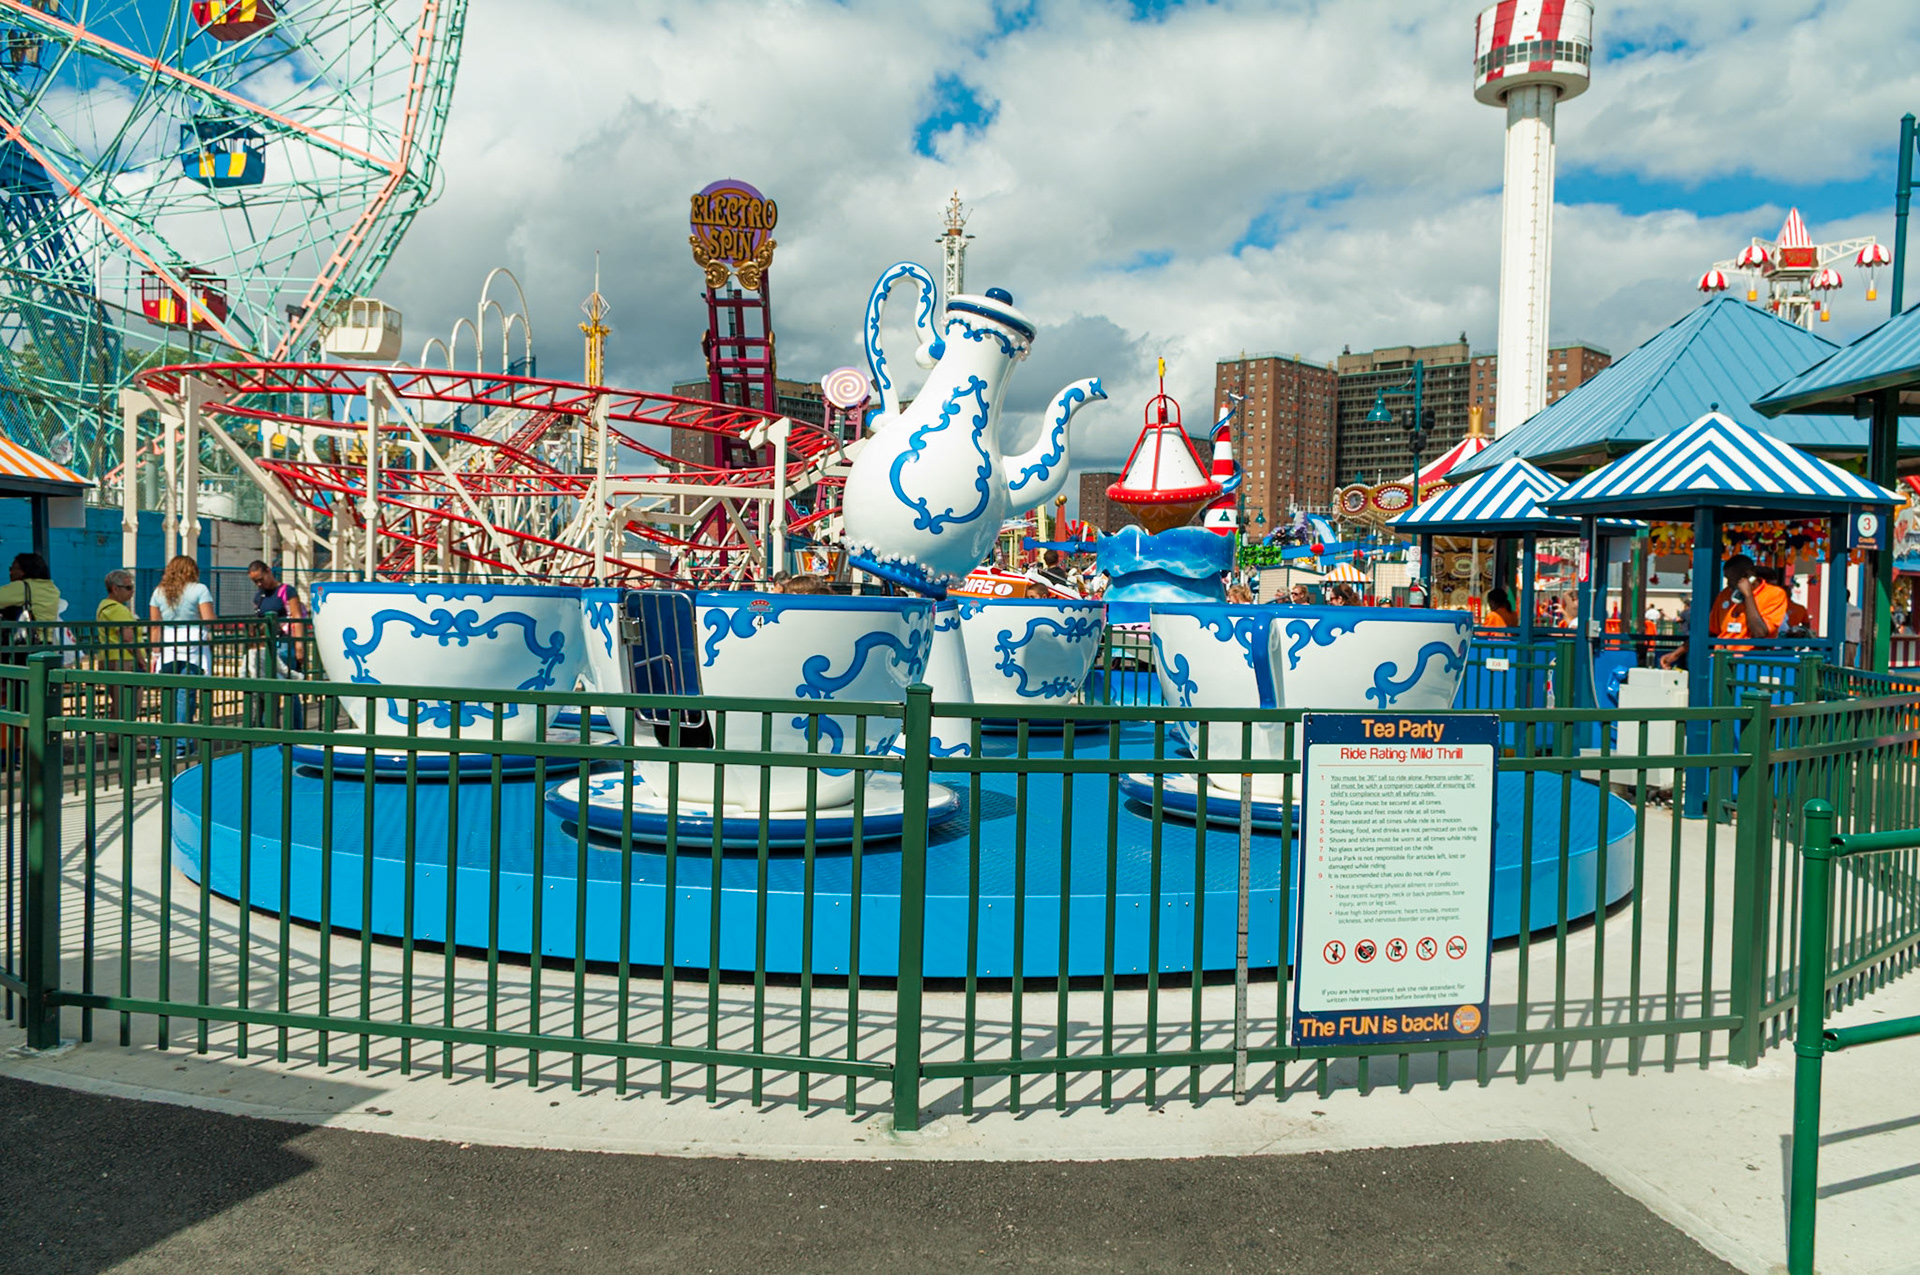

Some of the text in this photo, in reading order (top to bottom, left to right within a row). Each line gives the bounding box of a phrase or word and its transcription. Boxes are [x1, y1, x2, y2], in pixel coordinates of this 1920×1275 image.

[690, 194, 777, 230] ELECTRO
[708, 229, 754, 260] SPIN
[1863, 518, 1871, 530] 3
[957, 578, 996, 594] MAS
[757, 616, 762, 628] 4
[1361, 719, 1444, 743] Tea Party
[1341, 747, 1463, 762] Ride Rating: Mild Thrill
[1299, 1018, 1336, 1038] The
[1339, 1015, 1379, 1036] FUN
[1382, 1015, 1398, 1034] is
[1402, 1012, 1449, 1033] back!
